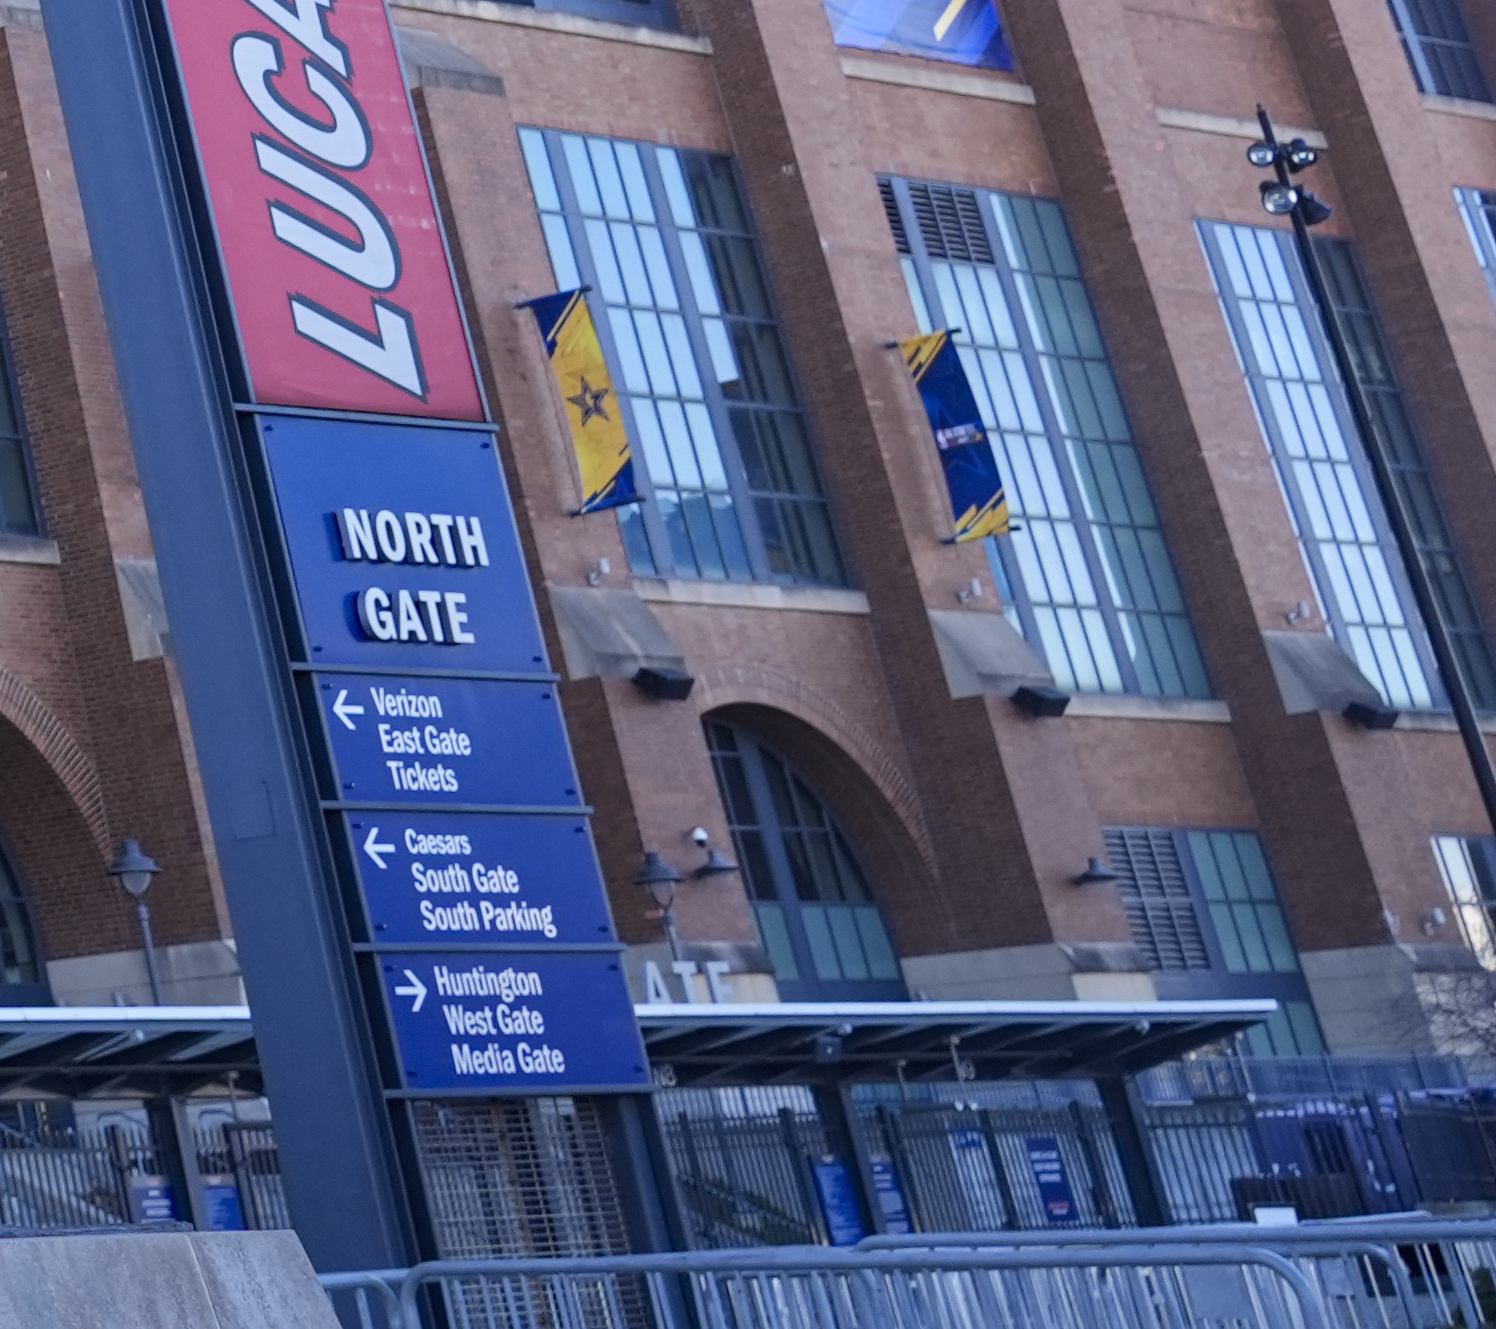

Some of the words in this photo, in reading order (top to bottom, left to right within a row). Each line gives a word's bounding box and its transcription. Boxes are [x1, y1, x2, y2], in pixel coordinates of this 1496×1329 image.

[335, 506, 490, 569] NORTH
[357, 587, 476, 645] GATE
[369, 686, 443, 719] Verizon
[378, 723, 421, 754] East
[424, 726, 472, 757] Gate
[386, 760, 459, 793] Tickets
[404, 828, 472, 856] Caesars
[413, 863, 470, 893] South
[471, 865, 520, 895] Gate
[420, 899, 479, 932] South
[482, 901, 557, 940] Parking
[434, 964, 543, 999] Huntington
[644, 960, 733, 1004] ATE
[443, 1003, 494, 1036] West
[495, 1005, 545, 1037] Gate
[452, 1043, 515, 1074] Media
[515, 1044, 566, 1075] Gate
